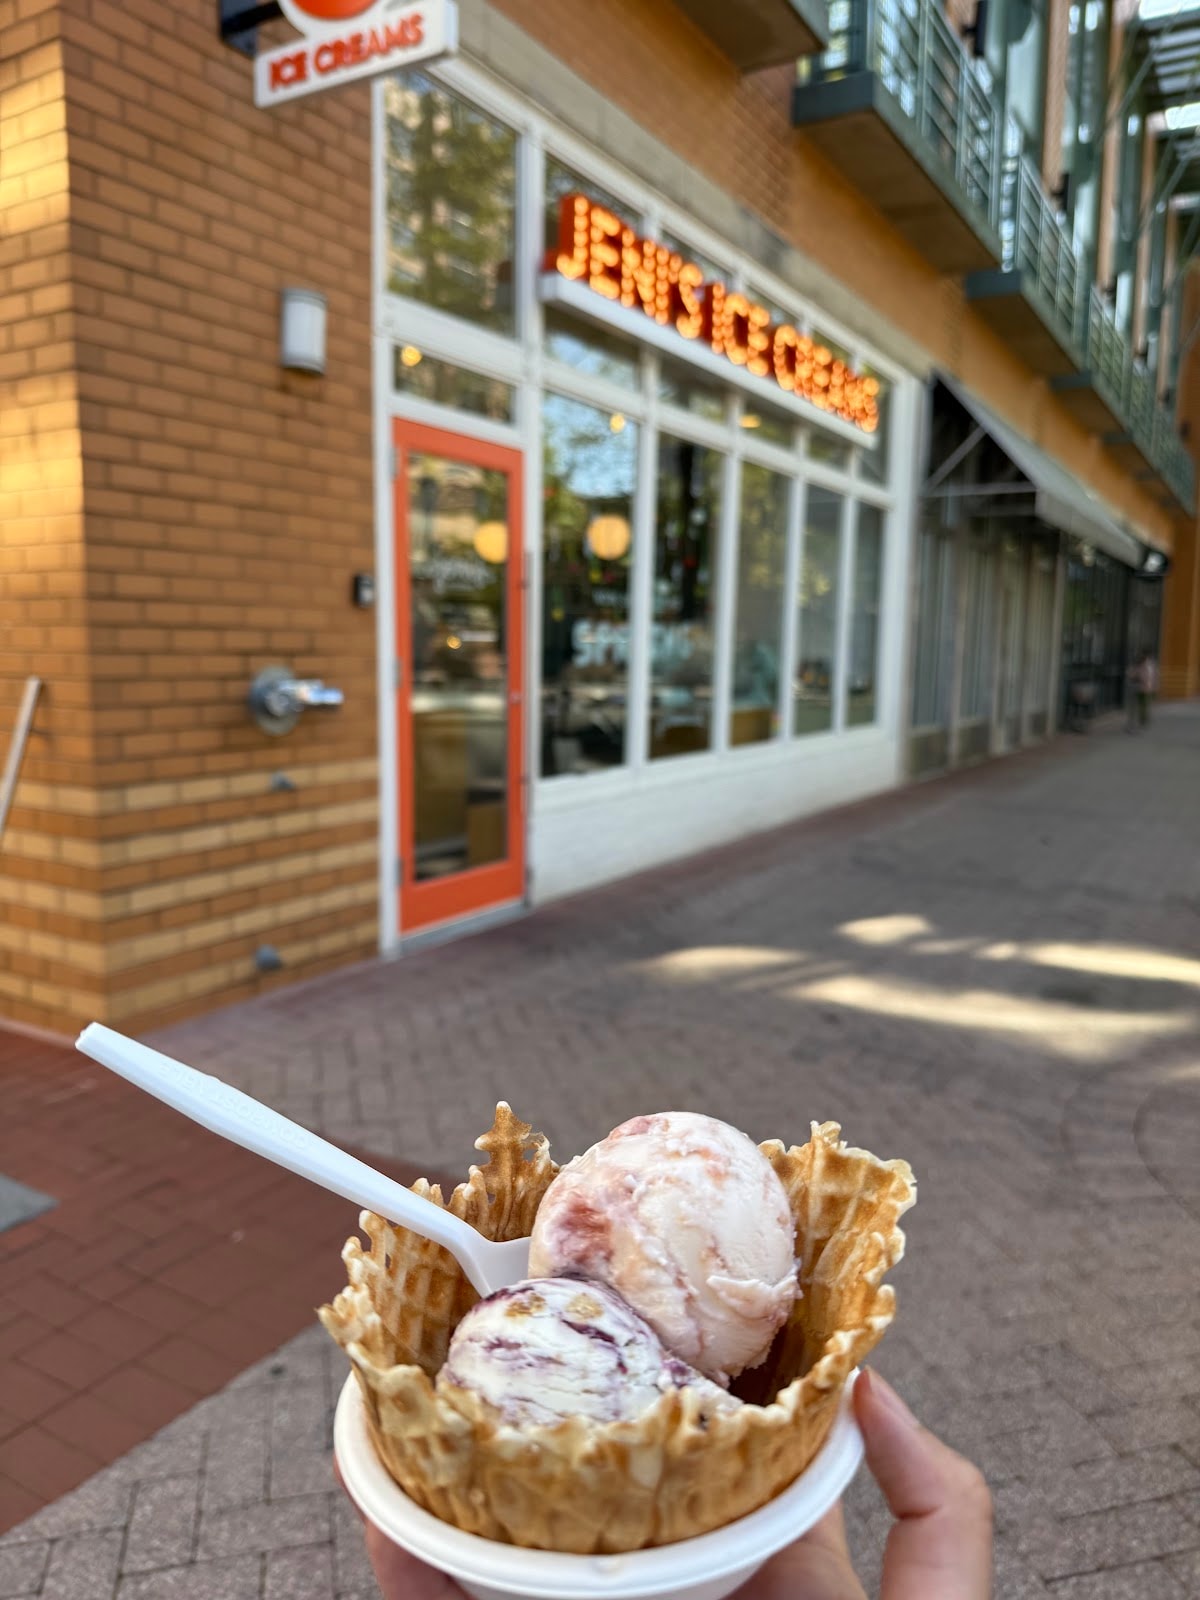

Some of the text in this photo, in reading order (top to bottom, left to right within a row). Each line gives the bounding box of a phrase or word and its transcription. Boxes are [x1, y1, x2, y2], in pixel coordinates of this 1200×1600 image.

[269, 12, 424, 91] ICE CREAMS
[553, 194, 703, 339] JENI'S
[709, 281, 769, 378] ICE
